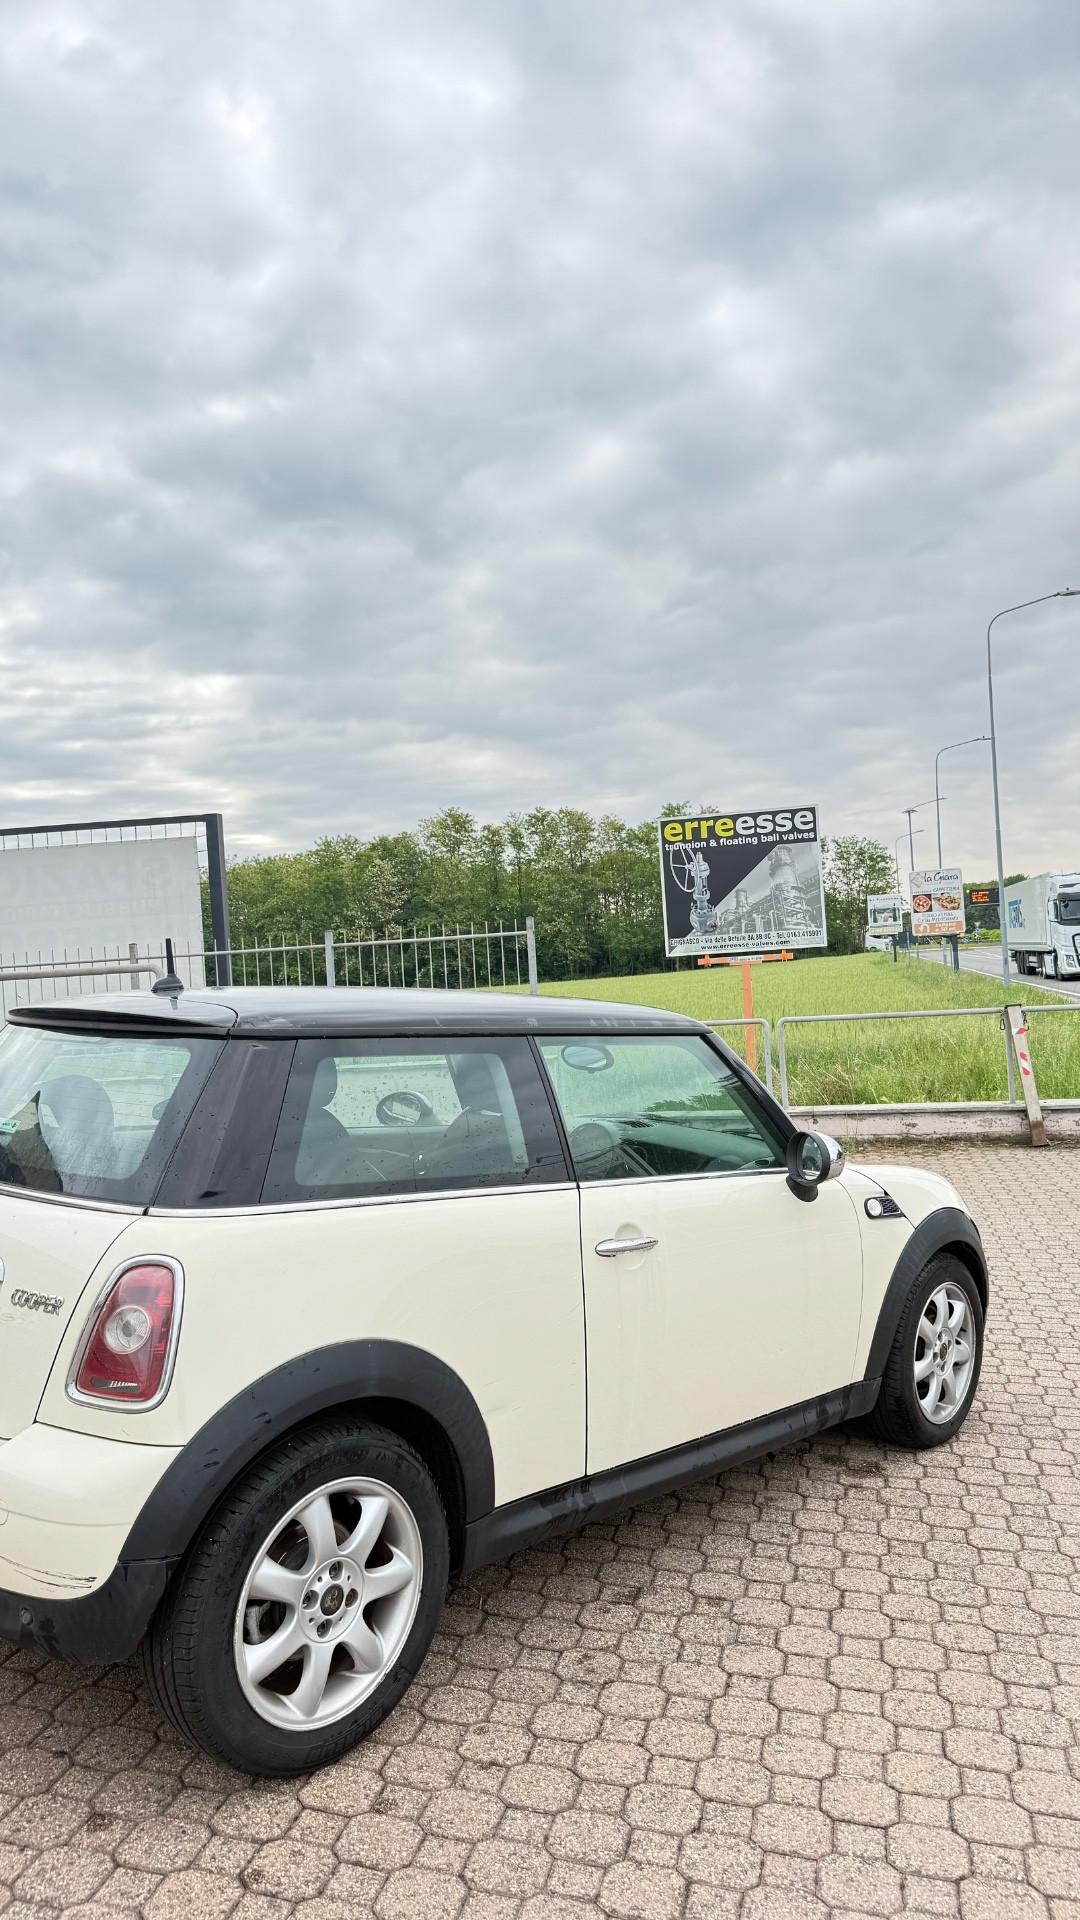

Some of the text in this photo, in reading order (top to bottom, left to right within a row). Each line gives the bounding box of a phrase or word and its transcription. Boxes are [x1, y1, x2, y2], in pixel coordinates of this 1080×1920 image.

[663, 810, 814, 842] erreesse
[665, 831, 815, 851] trunnion & floating ball valves
[701, 940, 790, 950] www.erreesse-valves.com
[11, 1288, 64, 1316] COOPER
